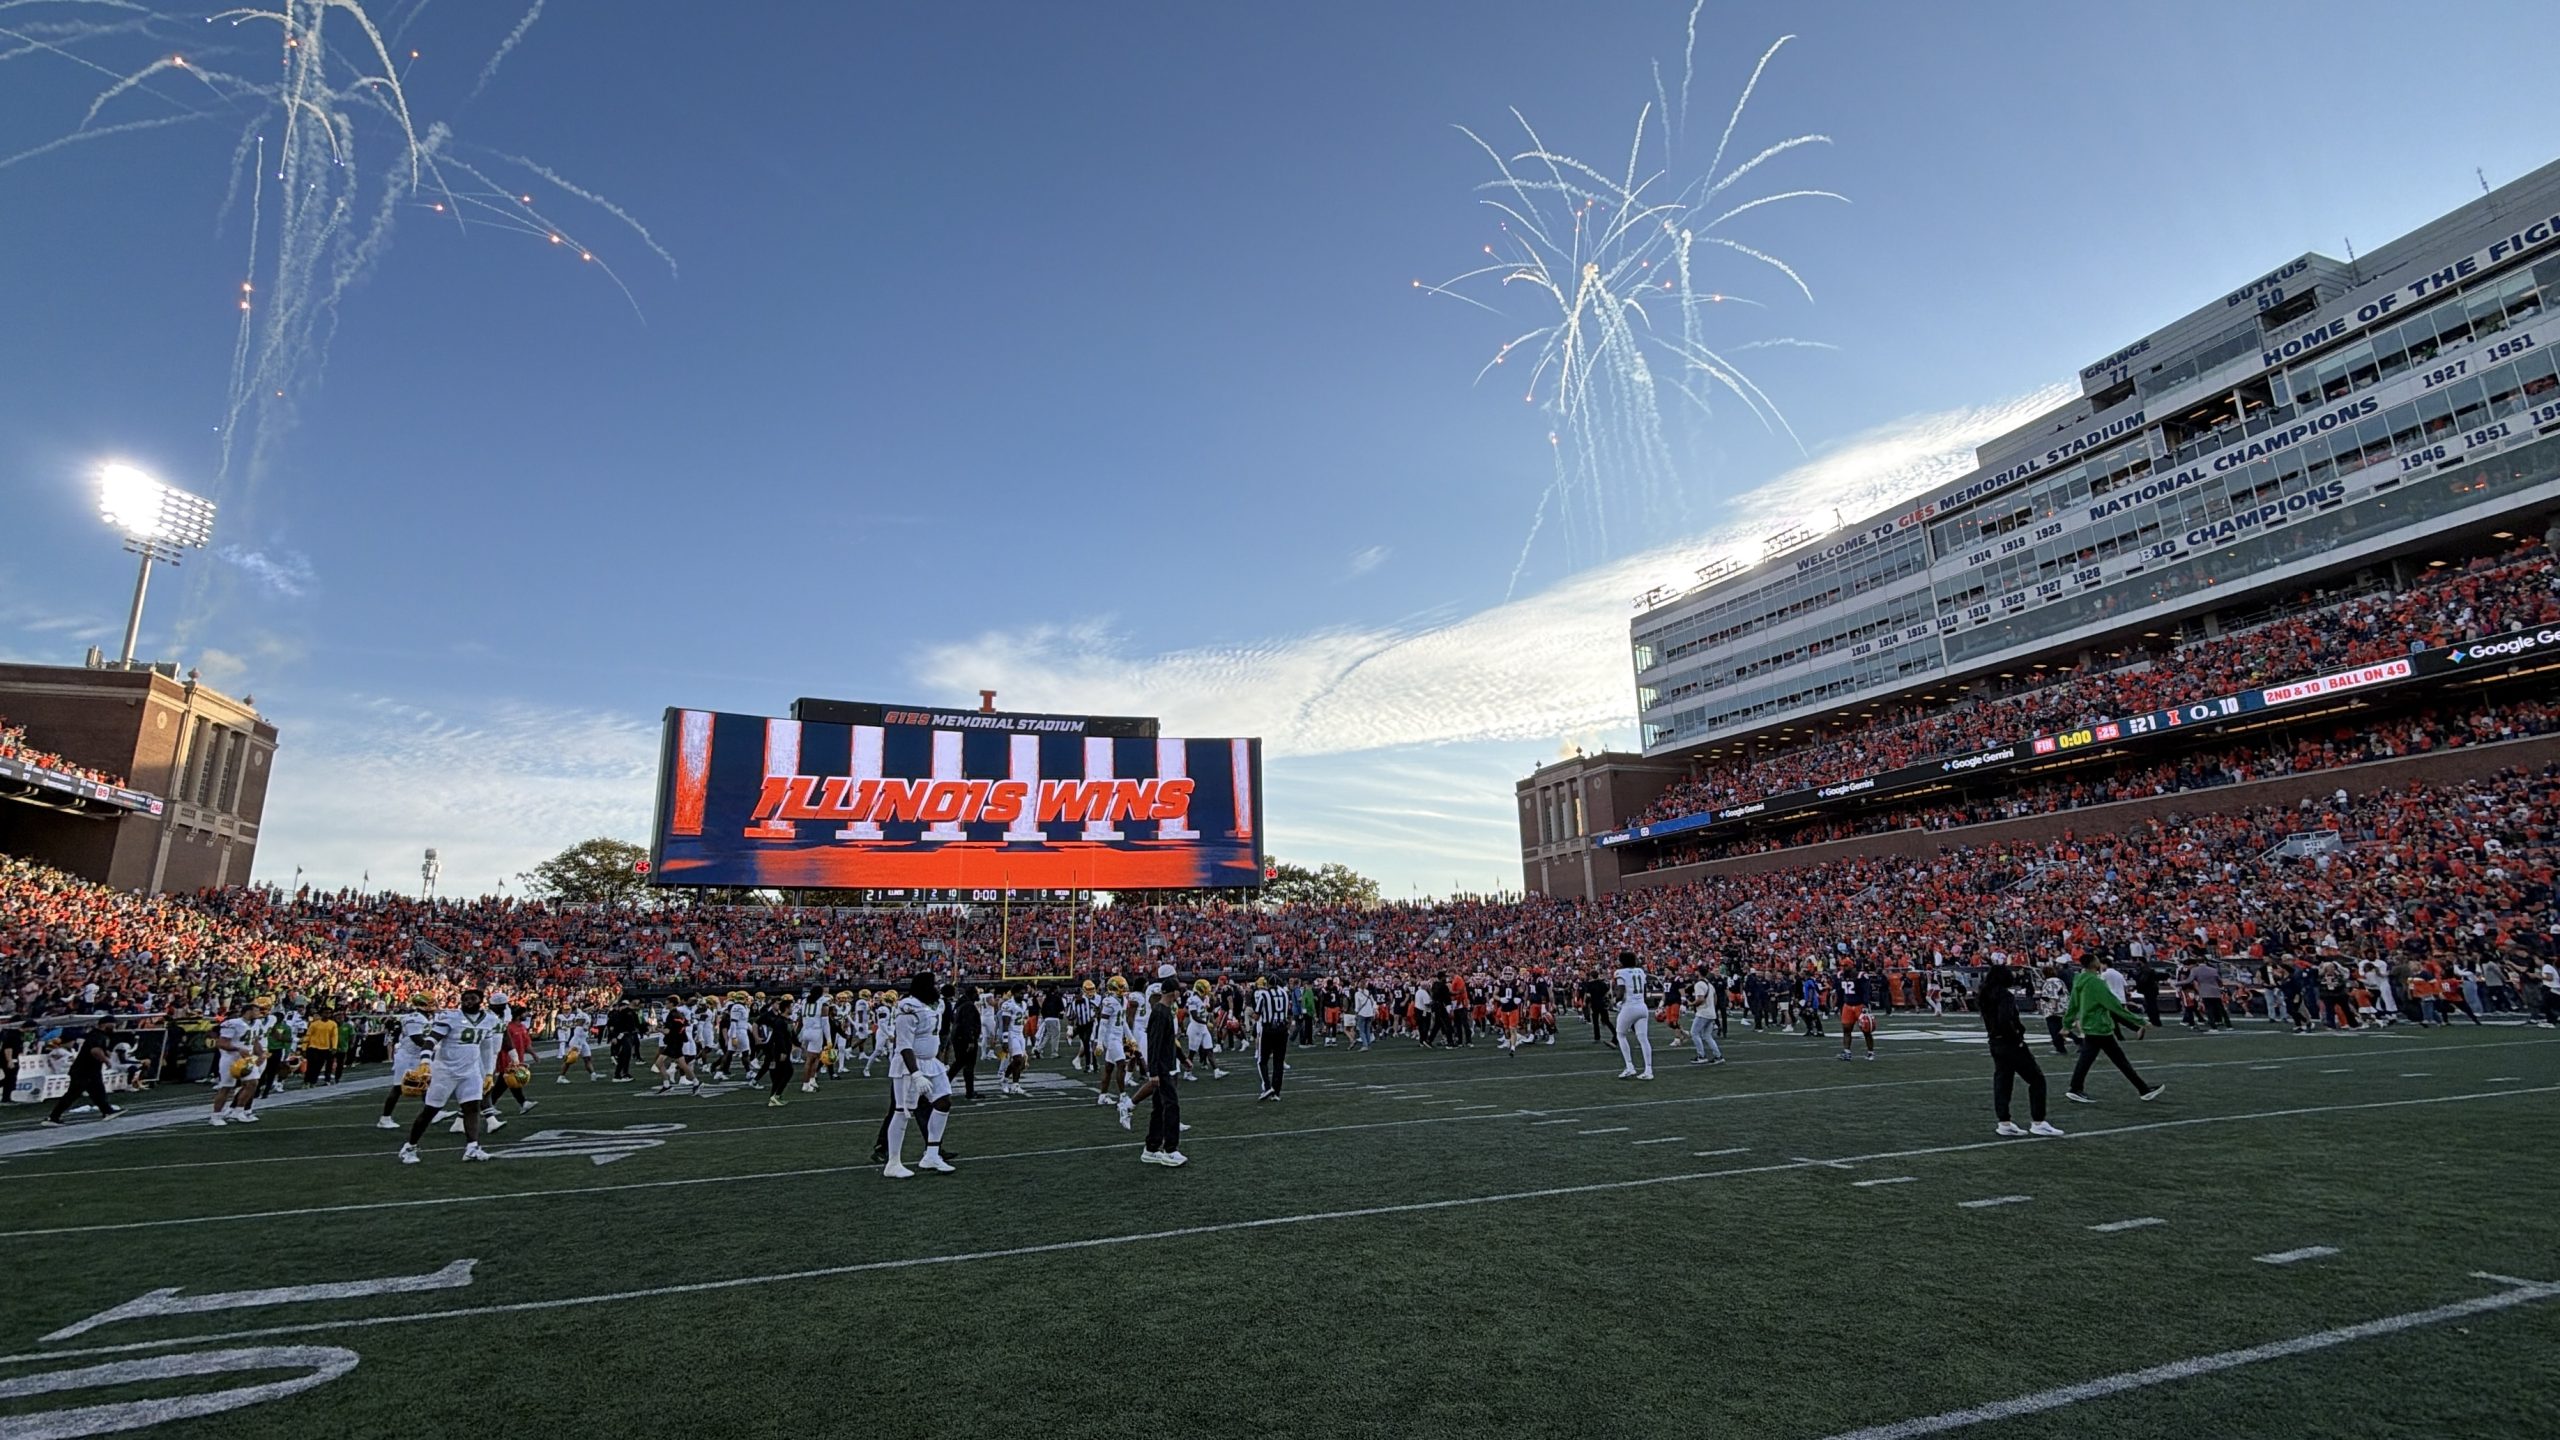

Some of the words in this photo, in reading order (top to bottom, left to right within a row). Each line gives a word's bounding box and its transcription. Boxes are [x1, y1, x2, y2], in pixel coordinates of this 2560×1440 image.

[2227, 258, 2308, 308] BUTKUS
[2257, 287, 2284, 312] 50
[2263, 317, 2347, 367] HOME
[2357, 293, 2397, 322] OF
[2408, 255, 2478, 297] THE
[2084, 339, 2150, 379] GRANGE
[2422, 360, 2467, 388] 1927
[2487, 333, 2535, 363] 1951
[2109, 364, 2129, 385] 77
[2401, 445, 2446, 471] 1946
[2464, 422, 2511, 449] 1951
[2089, 467, 2207, 522] NATIONAL
[2213, 396, 2379, 472] CHAMPIONS
[1796, 533, 1868, 571] WELCOME
[1871, 522, 1894, 541] TO
[1898, 504, 1936, 529] GIES
[1939, 460, 2041, 511] MEMORIAL
[2046, 411, 2146, 465] STADIUM
[2186, 480, 2346, 546] CHAMPIONS
[1968, 549, 1992, 567] 1914
[2000, 536, 2026, 553] 1919
[2036, 523, 2062, 541] 1923
[1878, 634, 1899, 648] 1914
[1907, 624, 1928, 639] 1915
[1967, 603, 1991, 619] 1919
[2000, 592, 2026, 608] 1923
[2035, 579, 2062, 597] 1927
[2072, 566, 2101, 584] 1928
[2469, 636, 2536, 659] Google
[2328, 675, 2362, 689] BALL
[2364, 669, 2384, 682] ON
[2387, 663, 2407, 677] 49
[2266, 688, 2292, 703] 2ND
[2294, 686, 2303, 696] &
[2304, 682, 2320, 695] 10
[2219, 697, 2240, 715] 10
[884, 711, 931, 726] GIES
[931, 714, 1015, 730] MEMORIAL
[1017, 718, 1085, 733] STADIUM
[2136, 715, 2156, 733] 21
[2059, 729, 2092, 748] 0:00
[1951, 755, 1982, 770] Google
[1982, 748, 2015, 763] Gemini
[1825, 785, 1849, 797] Google
[1849, 778, 1875, 791] Gemini
[750, 775, 1030, 823] ILLINOIS
[1035, 778, 1195, 823] WINS
[1724, 808, 1745, 818] Google
[1745, 802, 1765, 813] Gemini
[866, 889, 882, 901] 21
[913, 888, 919, 897] 3
[931, 888, 938, 897] 2
[948, 889, 957, 897] 10
[973, 889, 997, 901] 0:00
[1633, 975, 1643, 994] 11
[1841, 981, 1855, 995] 92
[1274, 996, 1284, 1012] U
